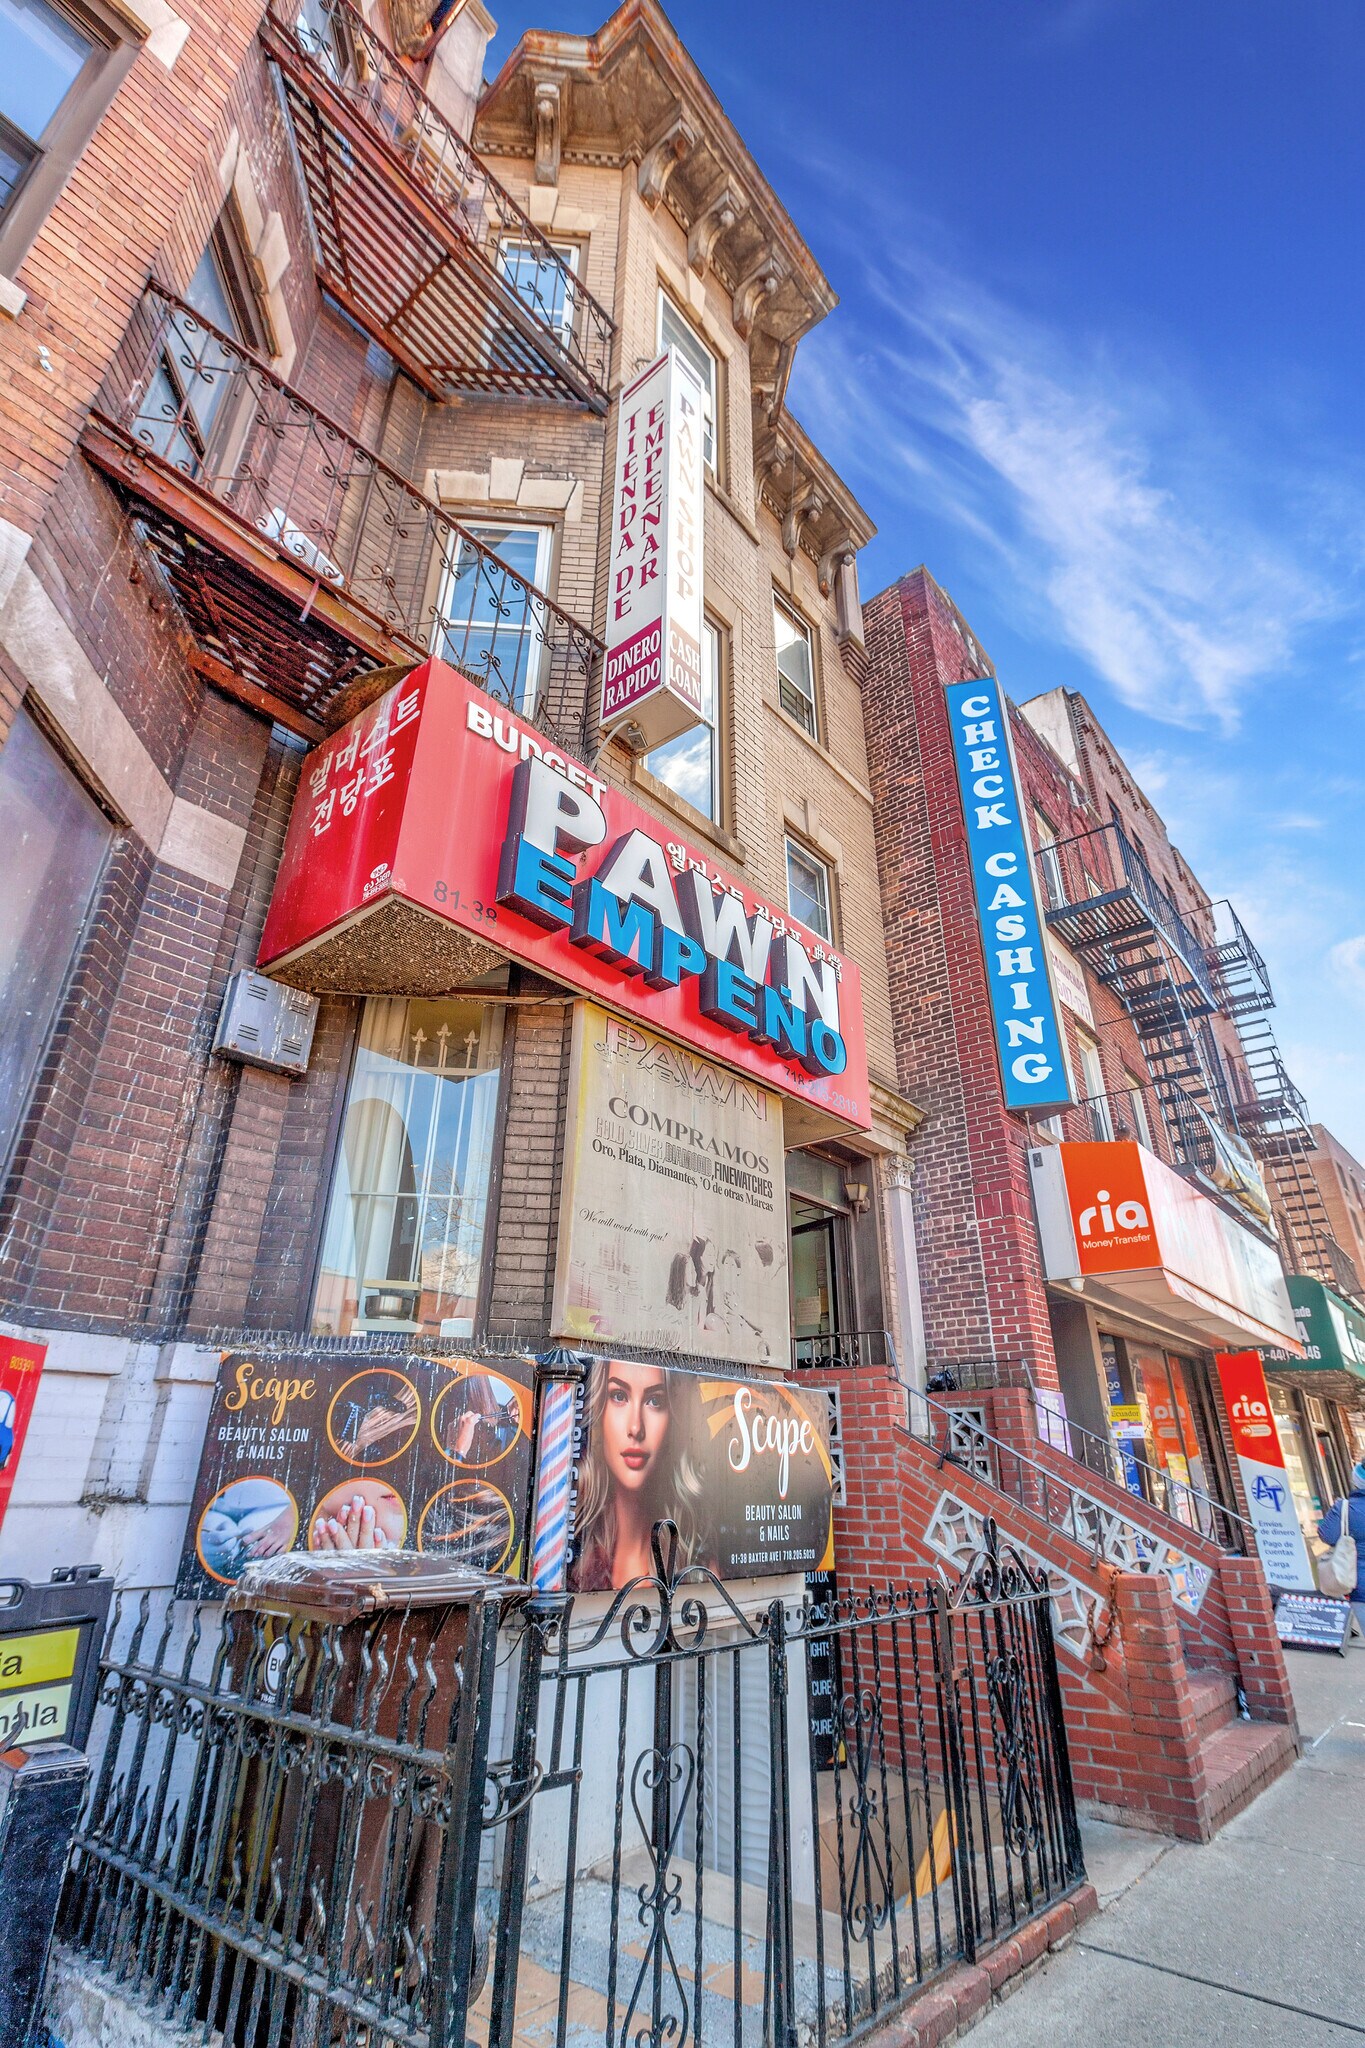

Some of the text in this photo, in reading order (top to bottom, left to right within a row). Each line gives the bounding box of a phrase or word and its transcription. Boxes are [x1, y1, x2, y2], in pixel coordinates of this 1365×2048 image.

[613, 407, 642, 623] TIENDA DE
[638, 399, 665, 592] EMPEÑAR
[676, 391, 697, 601] PAWN SHOP
[607, 628, 661, 683] DINERO
[669, 628, 701, 676] CASH
[605, 656, 663, 712] RAPIDO
[669, 665, 701, 703] LOAN
[309, 688, 421, 798] 엘머스트
[309, 747, 396, 838] 전당포
[433, 880, 499, 930] 81-38
[513, 755, 840, 1034] PAWN
[960, 694, 1054, 1085] CHECK CASHING
[605, 1016, 768, 1122] PAWN
[608, 1096, 770, 1175] COMPRAMOS
[592, 1138, 616, 1161] Oro,
[618, 1147, 646, 1171] Plata,
[648, 1157, 699, 1190] Diamantes,
[712, 1182, 723, 1195] de
[723, 1187, 744, 1203] otras
[745, 1192, 774, 1212] Marcas
[1078, 1189, 1150, 1237] ria
[1082, 1233, 1152, 1251] Money Transfer
[224, 1362, 317, 1426] Scape
[1111, 1409, 1139, 1418] Ecuador
[1231, 1394, 1268, 1417] ria
[218, 1426, 310, 1442] BEAUTY SALON
[236, 1445, 285, 1460] & NAILS
[728, 1387, 815, 1500] Scape
[745, 1504, 802, 1521] BEAUTY SALON
[759, 1525, 790, 1542] & NAILS
[1271, 1528, 1296, 1537] dinero
[748, 1551, 769, 1564] BAXTER
[1262, 1539, 1294, 1548] Pago de
[1264, 1548, 1295, 1556] cuentas
[1267, 1560, 1291, 1569] Carga
[1269, 1571, 1300, 1581] Pasajes
